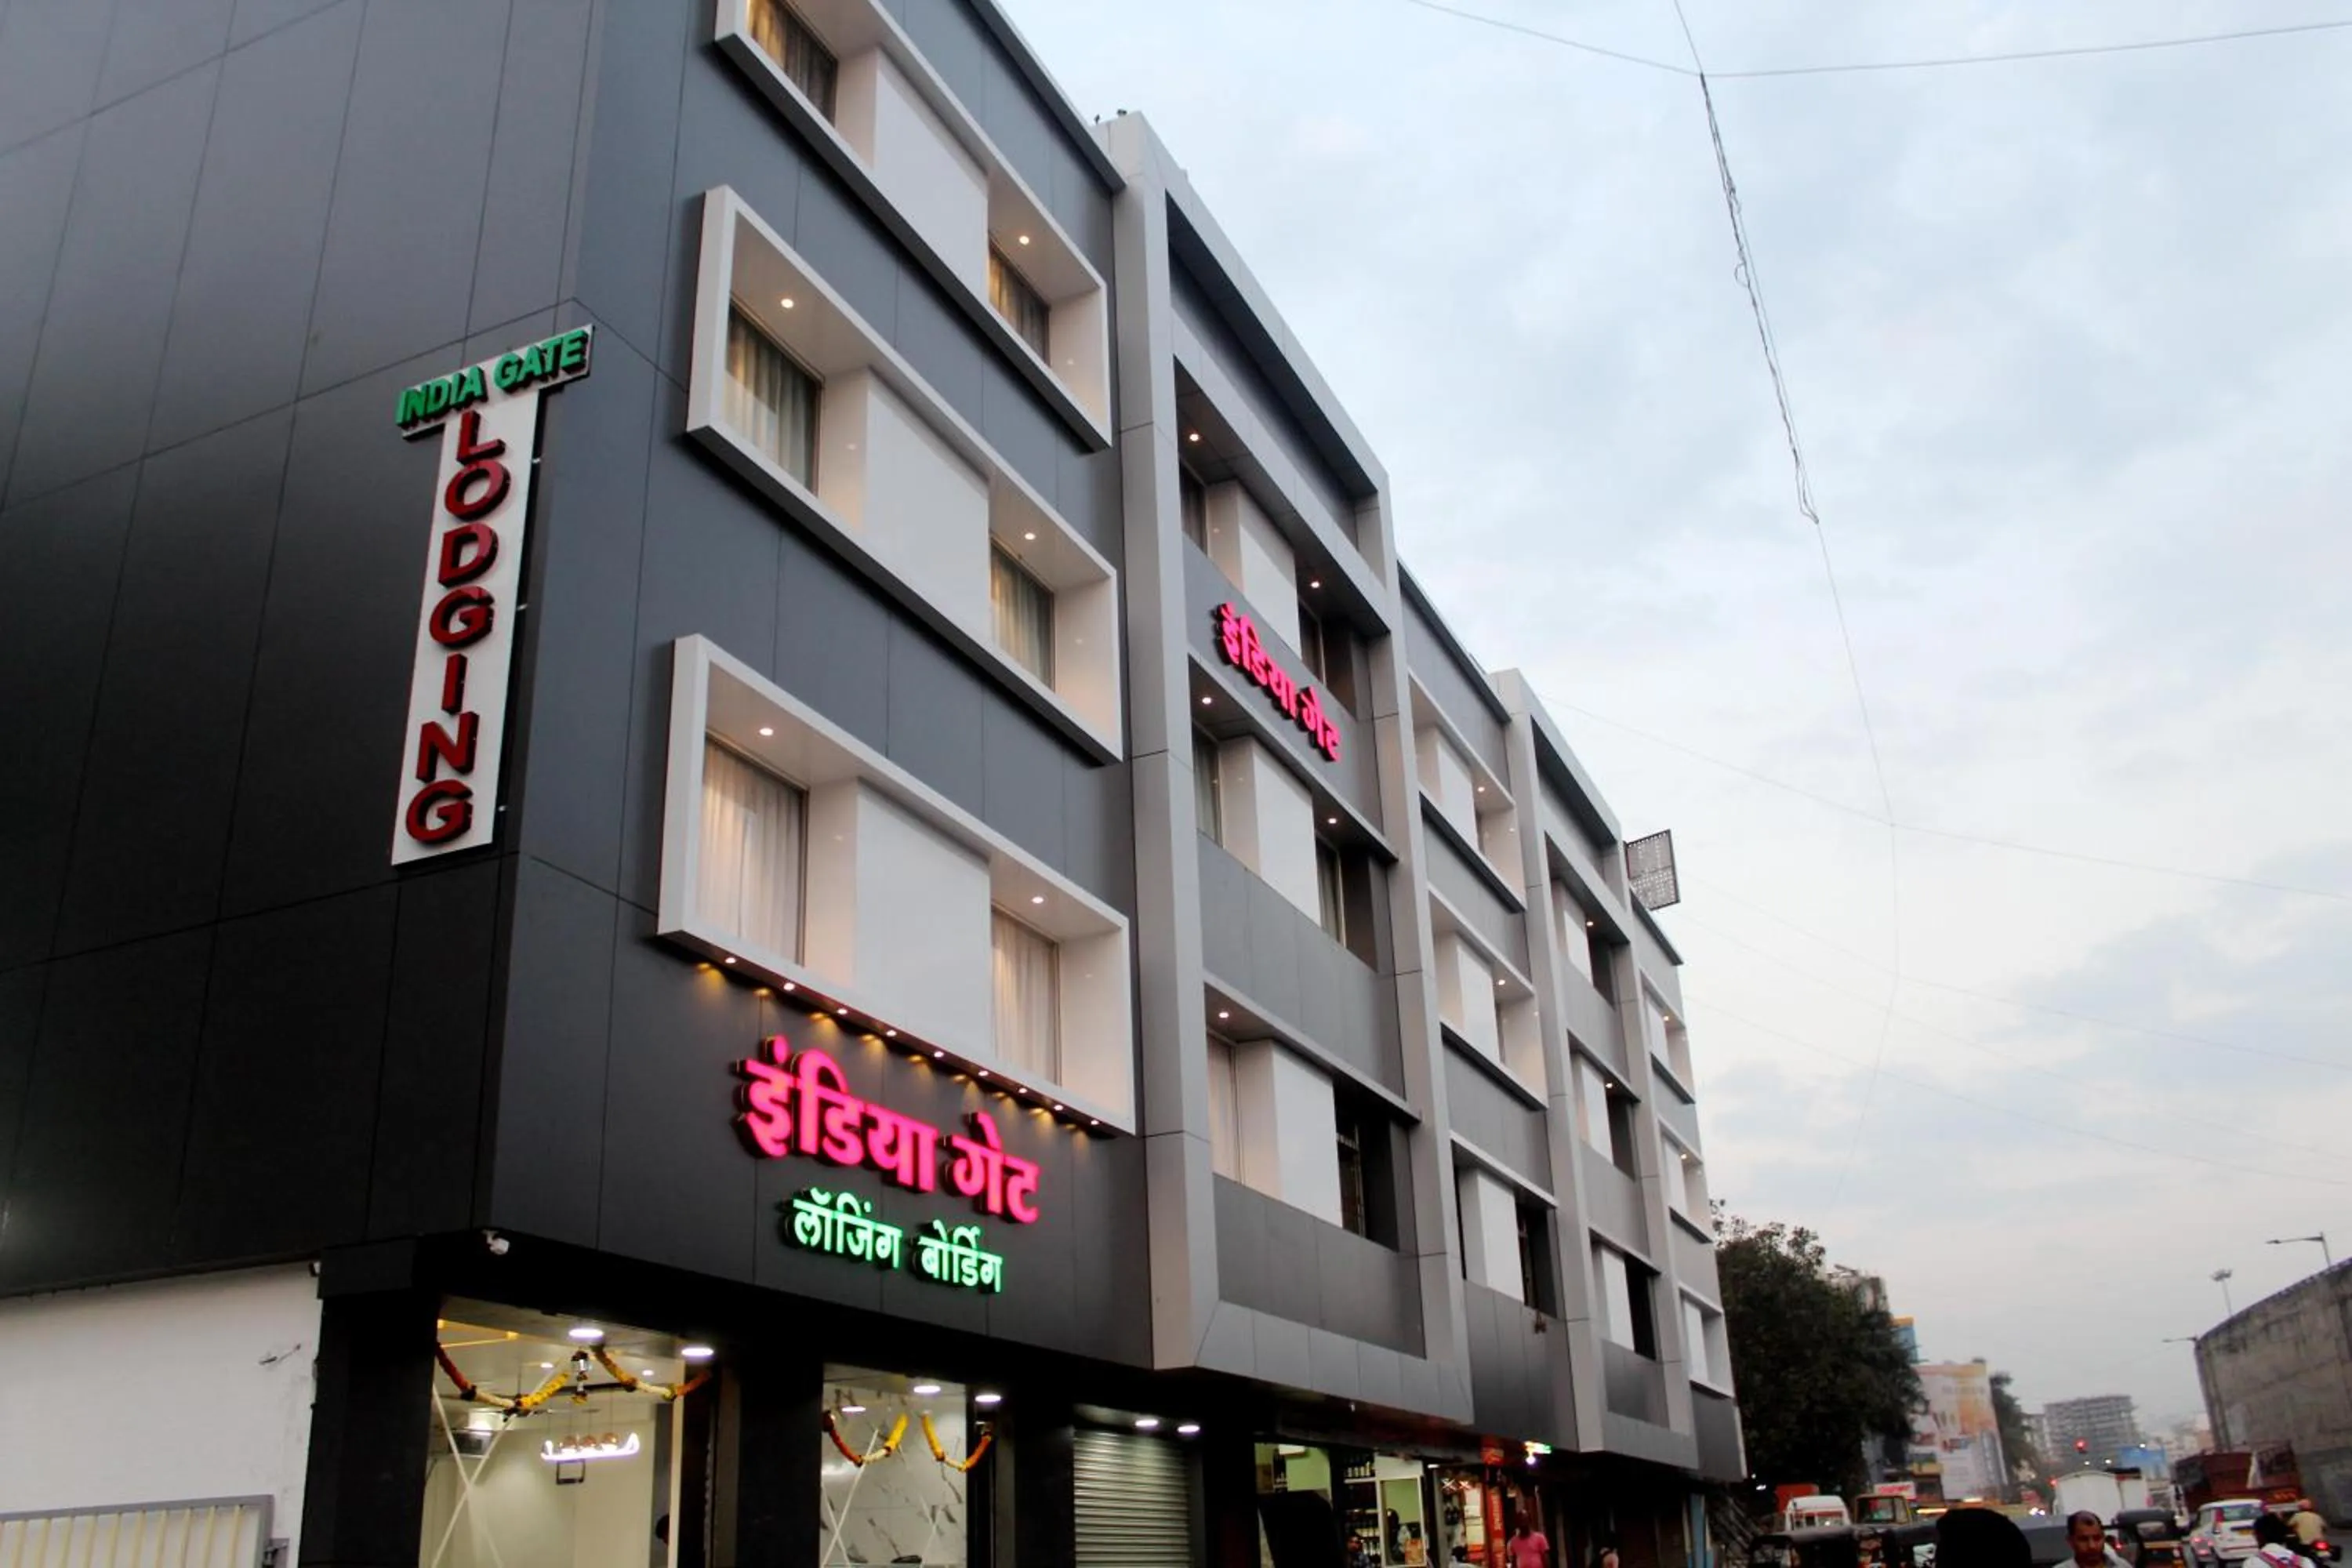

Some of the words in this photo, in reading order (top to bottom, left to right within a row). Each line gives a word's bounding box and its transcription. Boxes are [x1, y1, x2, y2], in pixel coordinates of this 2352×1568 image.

[396, 365, 488, 426] INDIA
[494, 329, 588, 393] GATE
[405, 409, 510, 844] LODGING
[1220, 601, 1298, 720] इंडिया
[1300, 685, 1341, 763] गेट
[744, 1035, 938, 1192] इंडिया
[949, 1111, 1040, 1223] गेट
[792, 1187, 903, 1269] लॉजिंग
